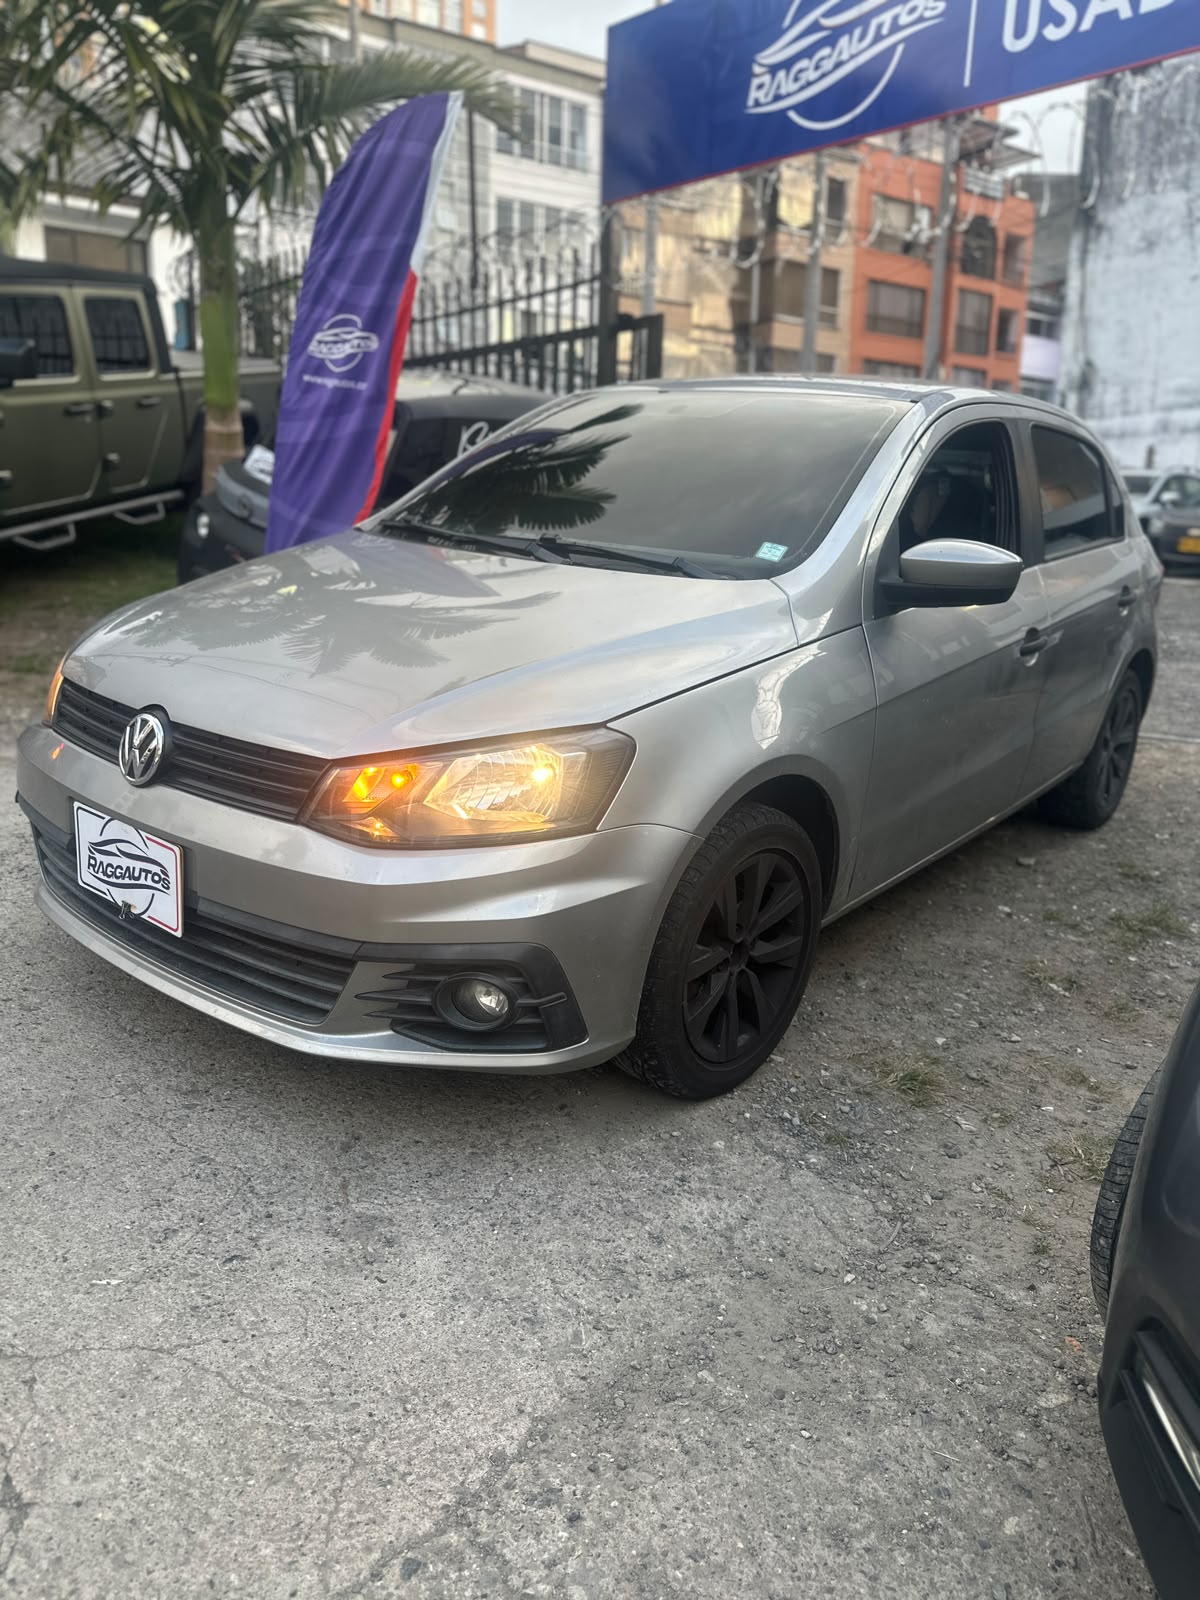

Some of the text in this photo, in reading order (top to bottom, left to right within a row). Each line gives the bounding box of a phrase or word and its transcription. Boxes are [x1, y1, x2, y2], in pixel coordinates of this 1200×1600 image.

[1002, 0, 1175, 52] USA
[746, 0, 947, 107] RAGGAUTOS
[87, 853, 171, 891] RAGGAUTOS
